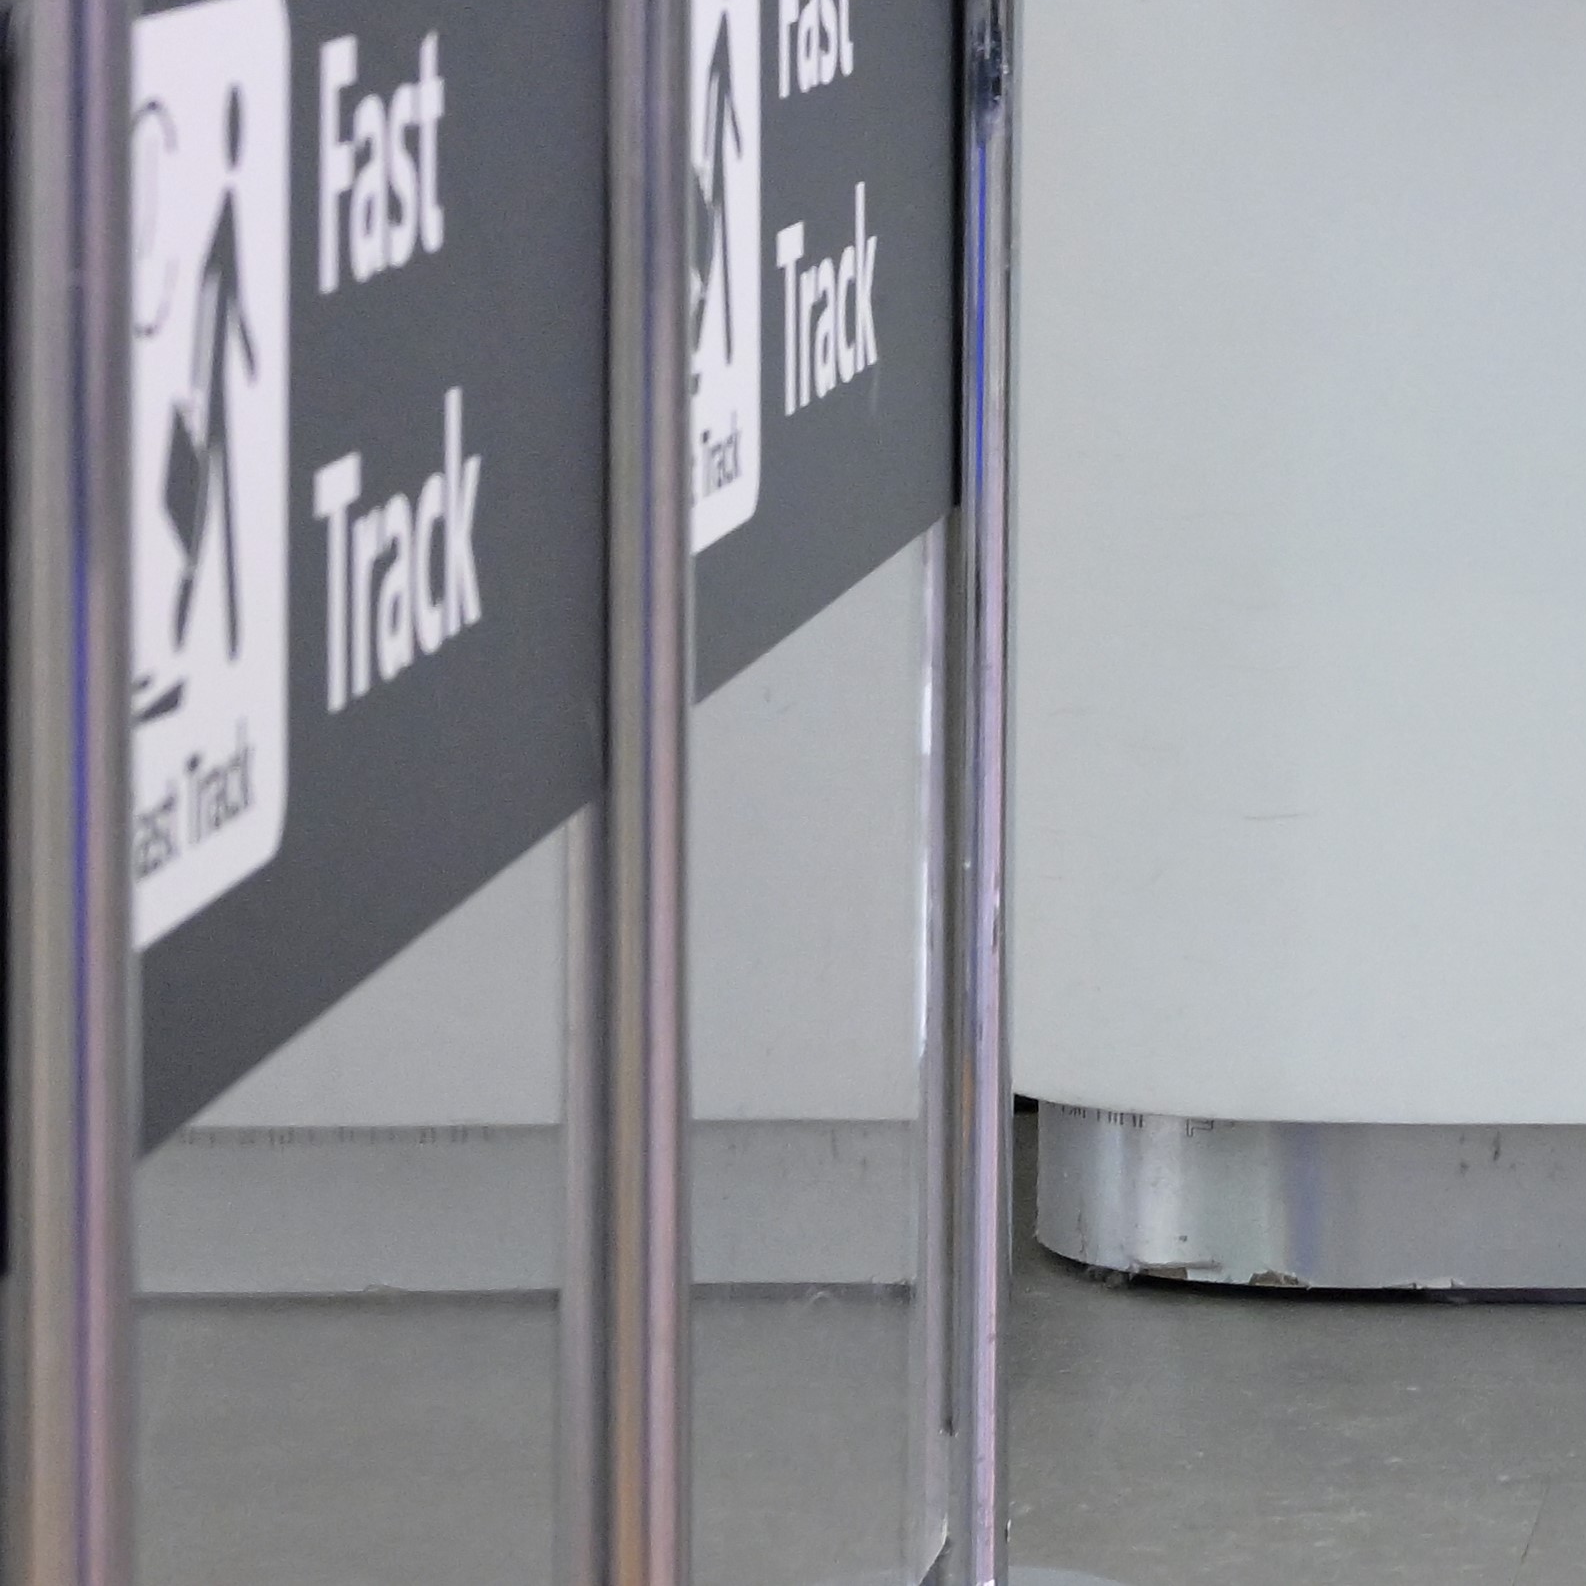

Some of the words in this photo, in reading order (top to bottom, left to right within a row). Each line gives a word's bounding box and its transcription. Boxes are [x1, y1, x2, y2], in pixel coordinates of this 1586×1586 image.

[318, 32, 445, 296] Fast
[775, 181, 878, 417] Track
[313, 386, 482, 713] Track
[133, 774, 181, 885] ast
[183, 714, 255, 845] Track
